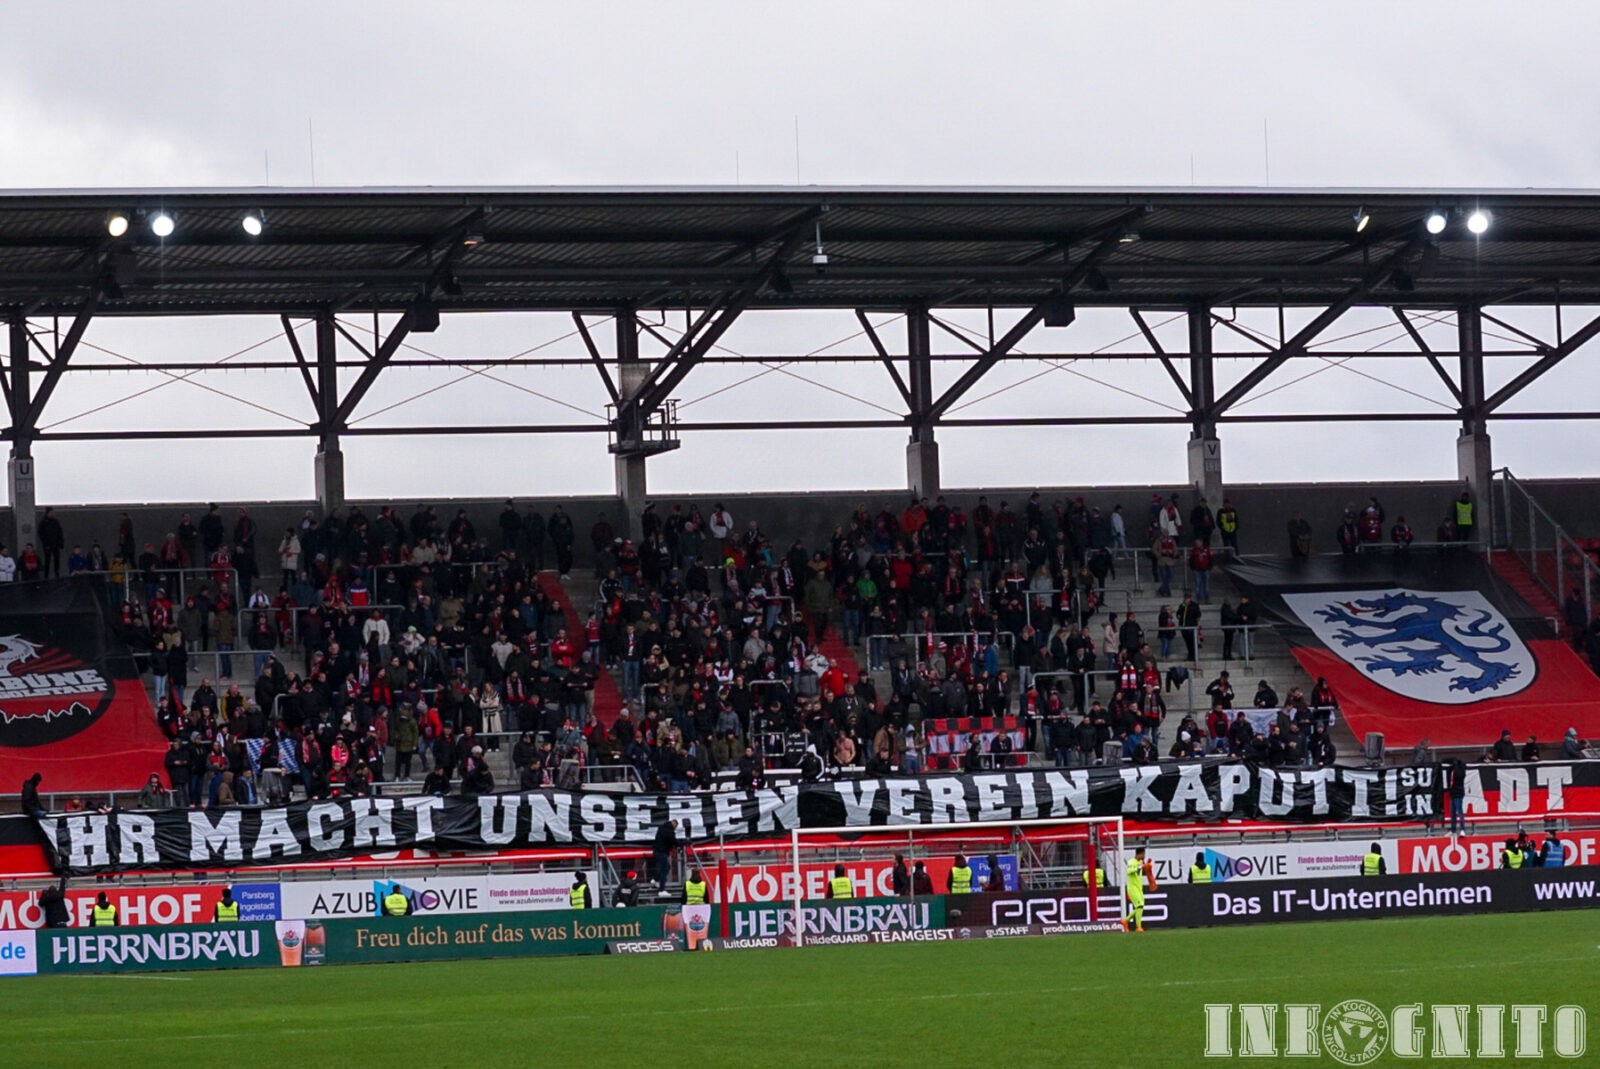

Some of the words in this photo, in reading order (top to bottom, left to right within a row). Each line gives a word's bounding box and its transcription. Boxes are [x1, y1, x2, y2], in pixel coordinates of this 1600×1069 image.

[0, 669, 105, 690] BÜNE
[1401, 768, 1433, 788] SU
[1443, 766, 1573, 814] ADT
[188, 796, 443, 861] MACHT
[478, 786, 800, 844] UNSEREN
[835, 770, 1091, 826] VEREIN
[1119, 764, 1398, 816] KAPUTT!
[1405, 794, 1434, 815] IN
[1214, 854, 1287, 877] MOVIE
[1213, 892, 1262, 916] Das
[1273, 883, 1492, 913] IT-Unternehmen
[1534, 881, 1600, 901] www.
[734, 902, 929, 937] HERRNBRÄU
[1042, 922, 1123, 935] produkte.prosis.de
[356, 929, 400, 948] Freu
[407, 925, 449, 946] dich
[455, 924, 489, 944] auf
[492, 923, 524, 943] das
[530, 927, 567, 941] was
[574, 920, 641, 939] kommt
[805, 932, 868, 945] hildeGUARD
[872, 928, 954, 943] TEAMGEIST
[52, 930, 260, 965] HERRNBRÄU
